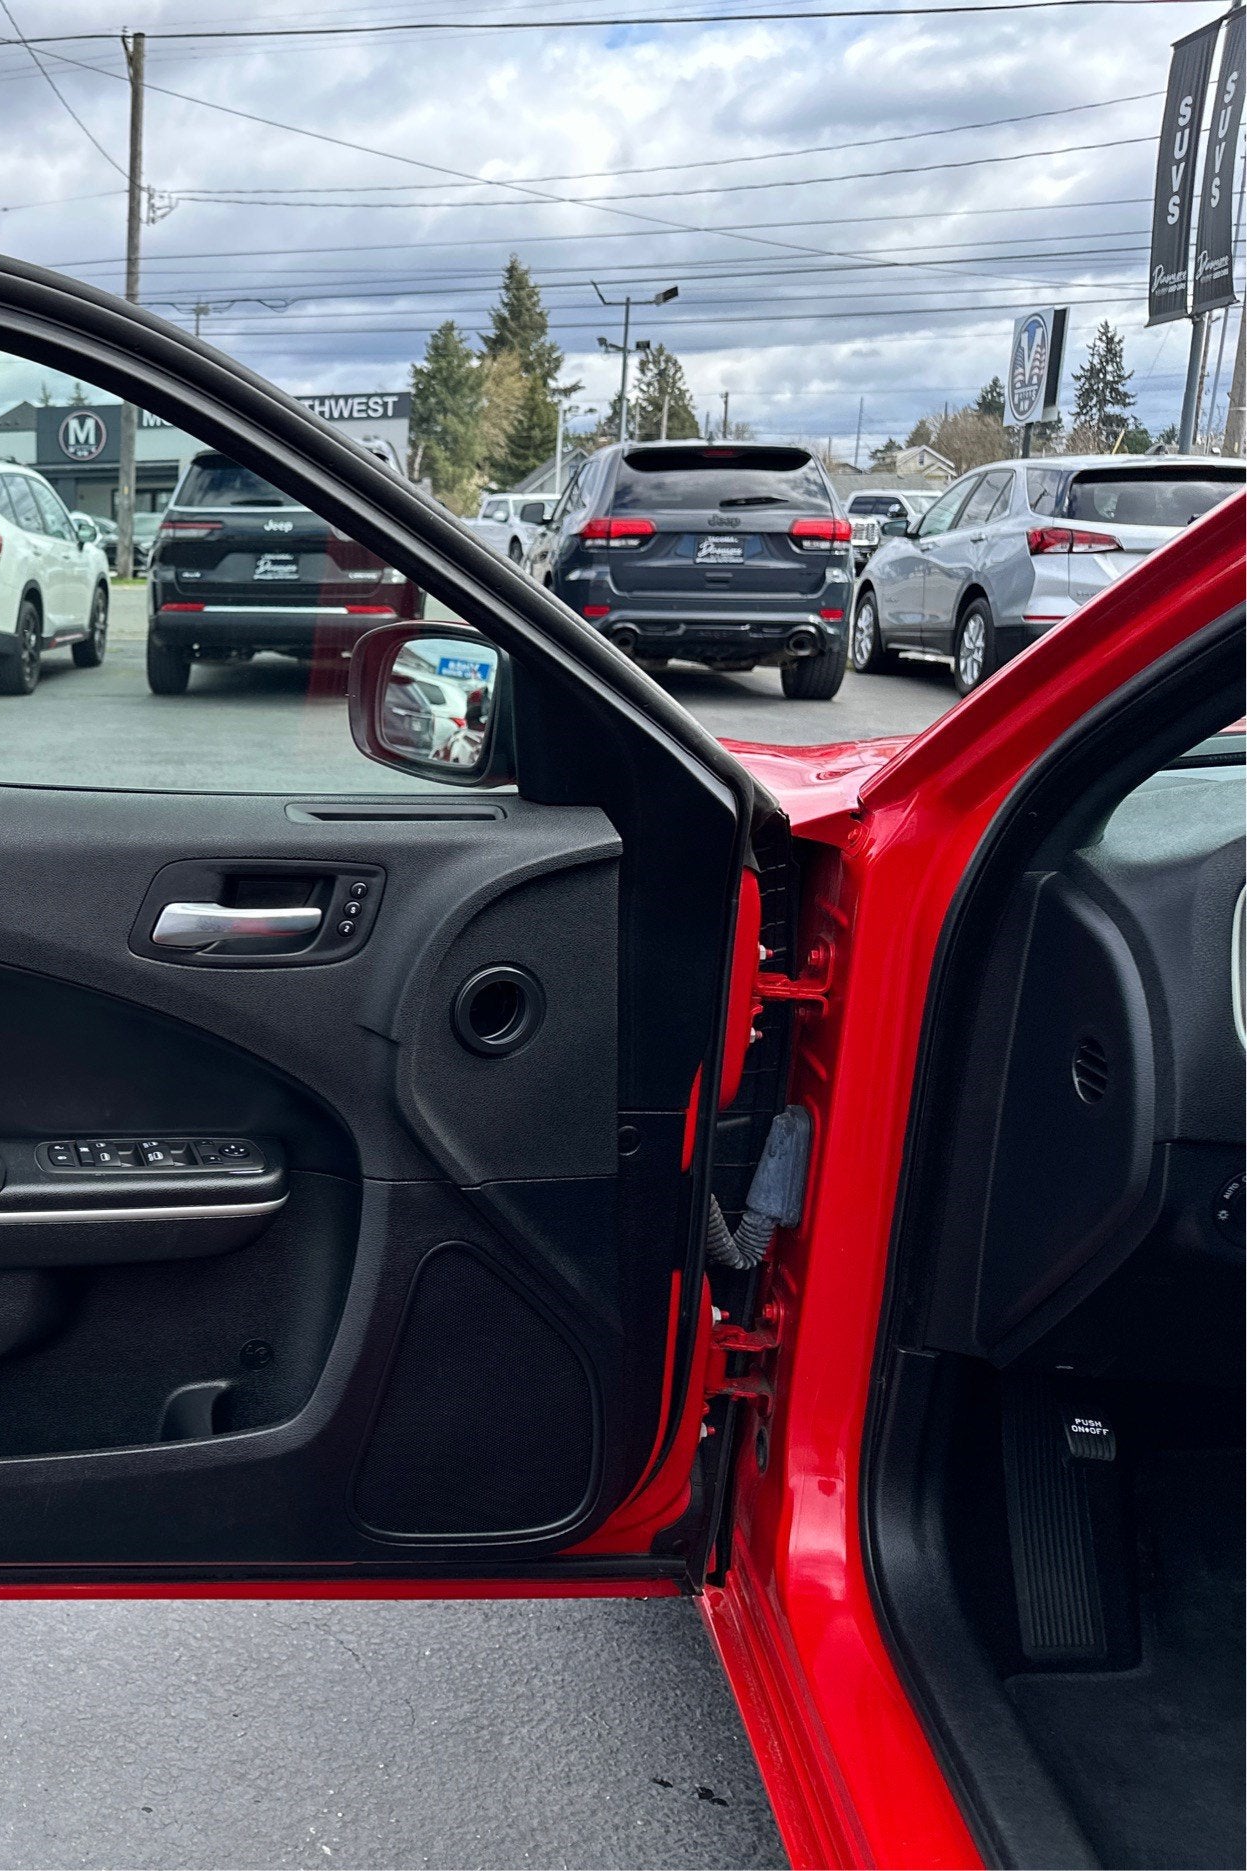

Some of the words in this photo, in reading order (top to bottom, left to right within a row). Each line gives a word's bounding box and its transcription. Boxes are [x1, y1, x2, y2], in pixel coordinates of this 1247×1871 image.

[1210, 71, 1238, 209] SUVS
[1166, 95, 1193, 226] SUVS
[300, 395, 399, 419] THWEST
[707, 513, 741, 529] Jeep
[1223, 1182, 1240, 1200] AUTO
[1074, 1418, 1102, 1428] PUSH
